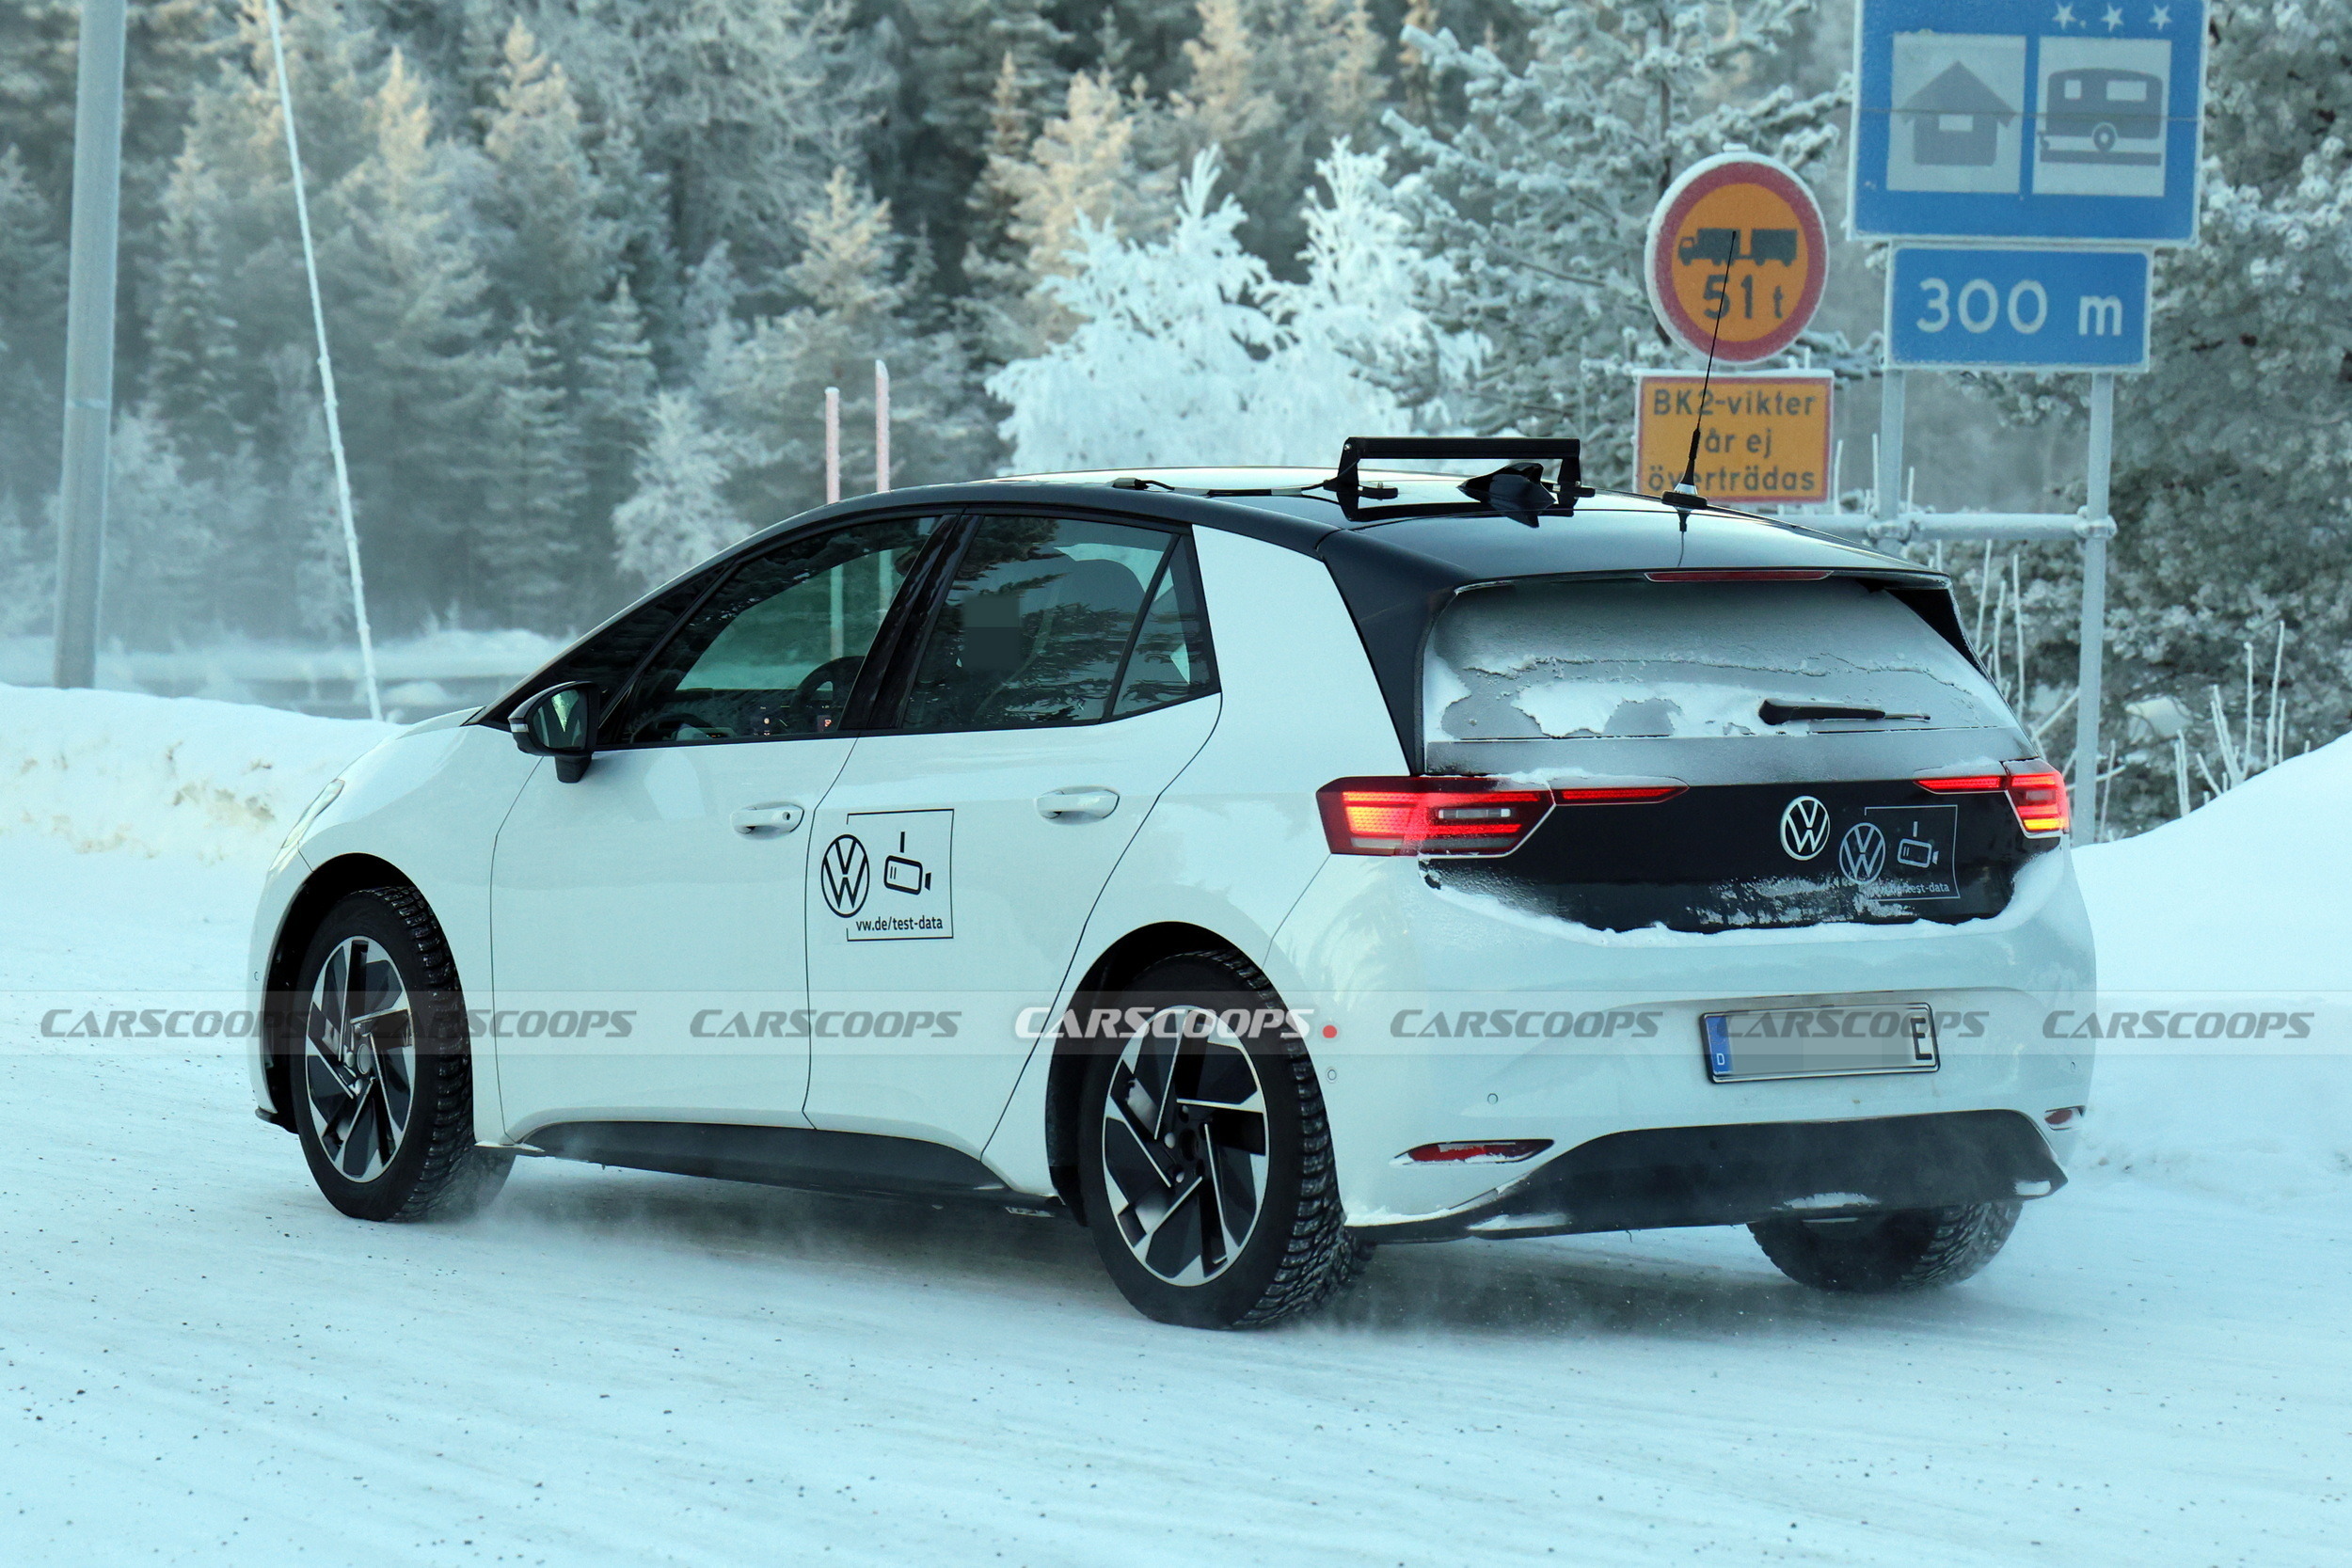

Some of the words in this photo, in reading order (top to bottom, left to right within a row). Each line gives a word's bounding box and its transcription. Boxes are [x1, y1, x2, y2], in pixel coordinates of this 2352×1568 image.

[1703, 274, 1754, 320] 51
[1772, 285, 1784, 319] t
[1915, 277, 2048, 334] 300
[2078, 294, 2122, 336] m
[1653, 388, 1816, 416] BK2-vikter
[1696, 427, 1736, 453] år
[1746, 428, 1772, 458] ej
[856, 915, 943, 931] vw.de/test-data
[1717, 1053, 1725, 1066] D
[1910, 1017, 1933, 1060] E
